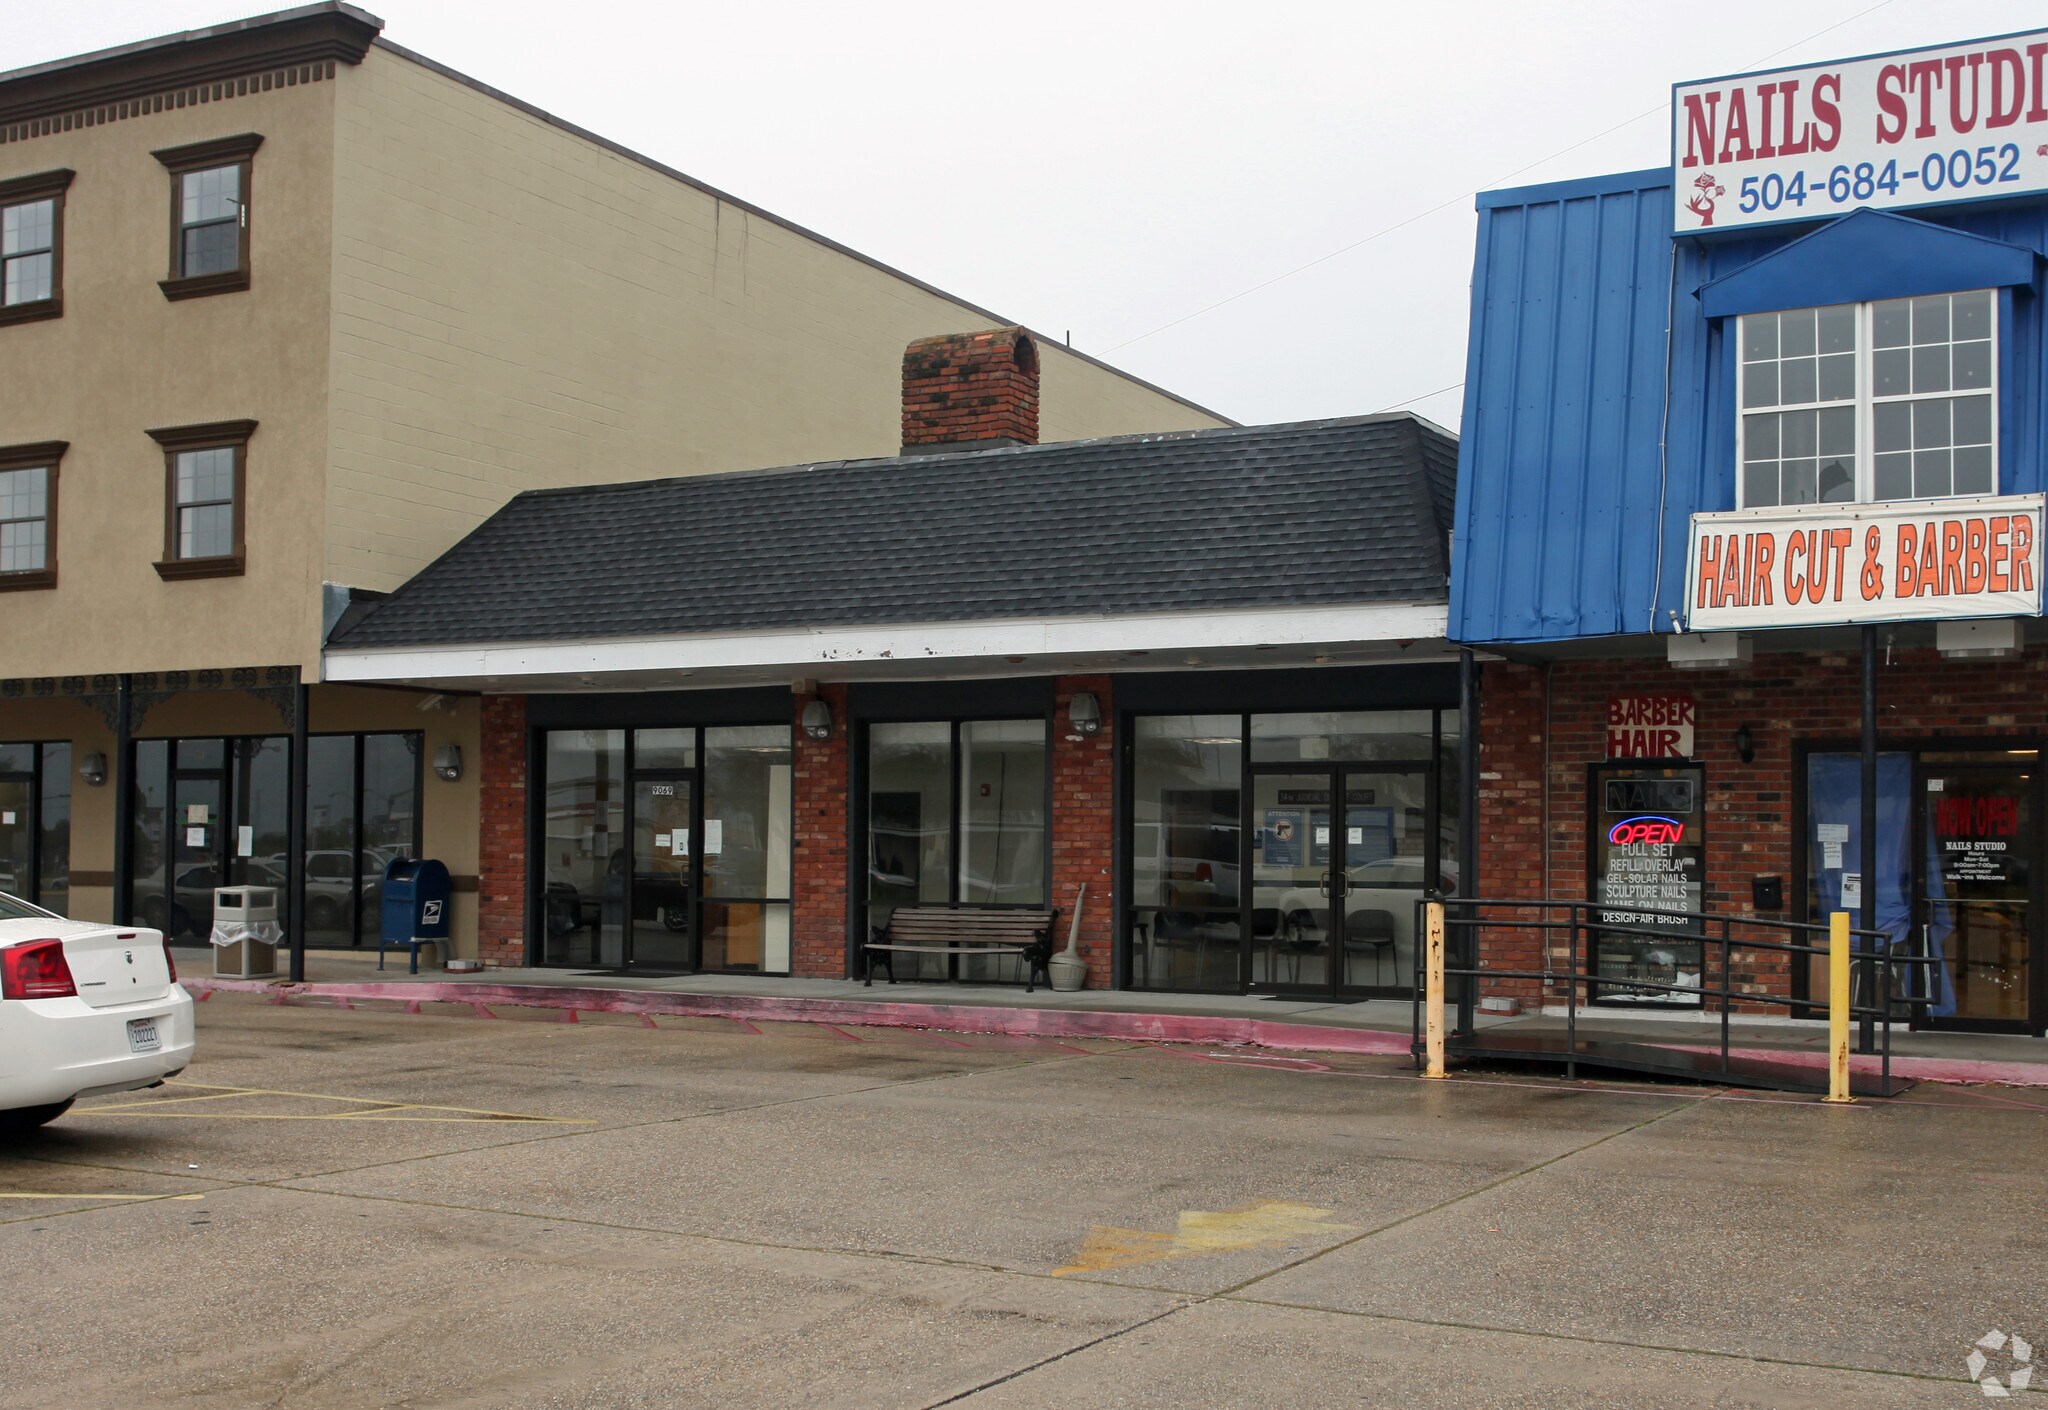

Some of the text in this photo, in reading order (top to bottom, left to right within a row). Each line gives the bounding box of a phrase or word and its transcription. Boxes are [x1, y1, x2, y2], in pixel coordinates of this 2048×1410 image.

[1683, 73, 1841, 167] NAILS
[1739, 143, 2020, 213] 504-684-0052
[1697, 514, 2033, 608] HAIR CUT & BARBER
[1607, 698, 1695, 726] BARBER
[1608, 729, 1684, 757] HAIR
[653, 786, 673, 795] 9069
[1937, 797, 2018, 836] NOW OPEN
[1612, 823, 1685, 845] OPEN
[1621, 843, 1675, 857] FULL SET
[1946, 841, 2006, 851] NAILS STUDIO
[1610, 858, 1685, 872] REFILL OVERLAY
[1606, 873, 1687, 884] GEL-SOLAR NAILS
[1606, 885, 1687, 899] SCULPTURE NAILS
[1658, 901, 1688, 912] NAILS
[1603, 912, 1688, 925] DESIGN-AIR BRUSH
[133, 1026, 157, 1043] 202227
